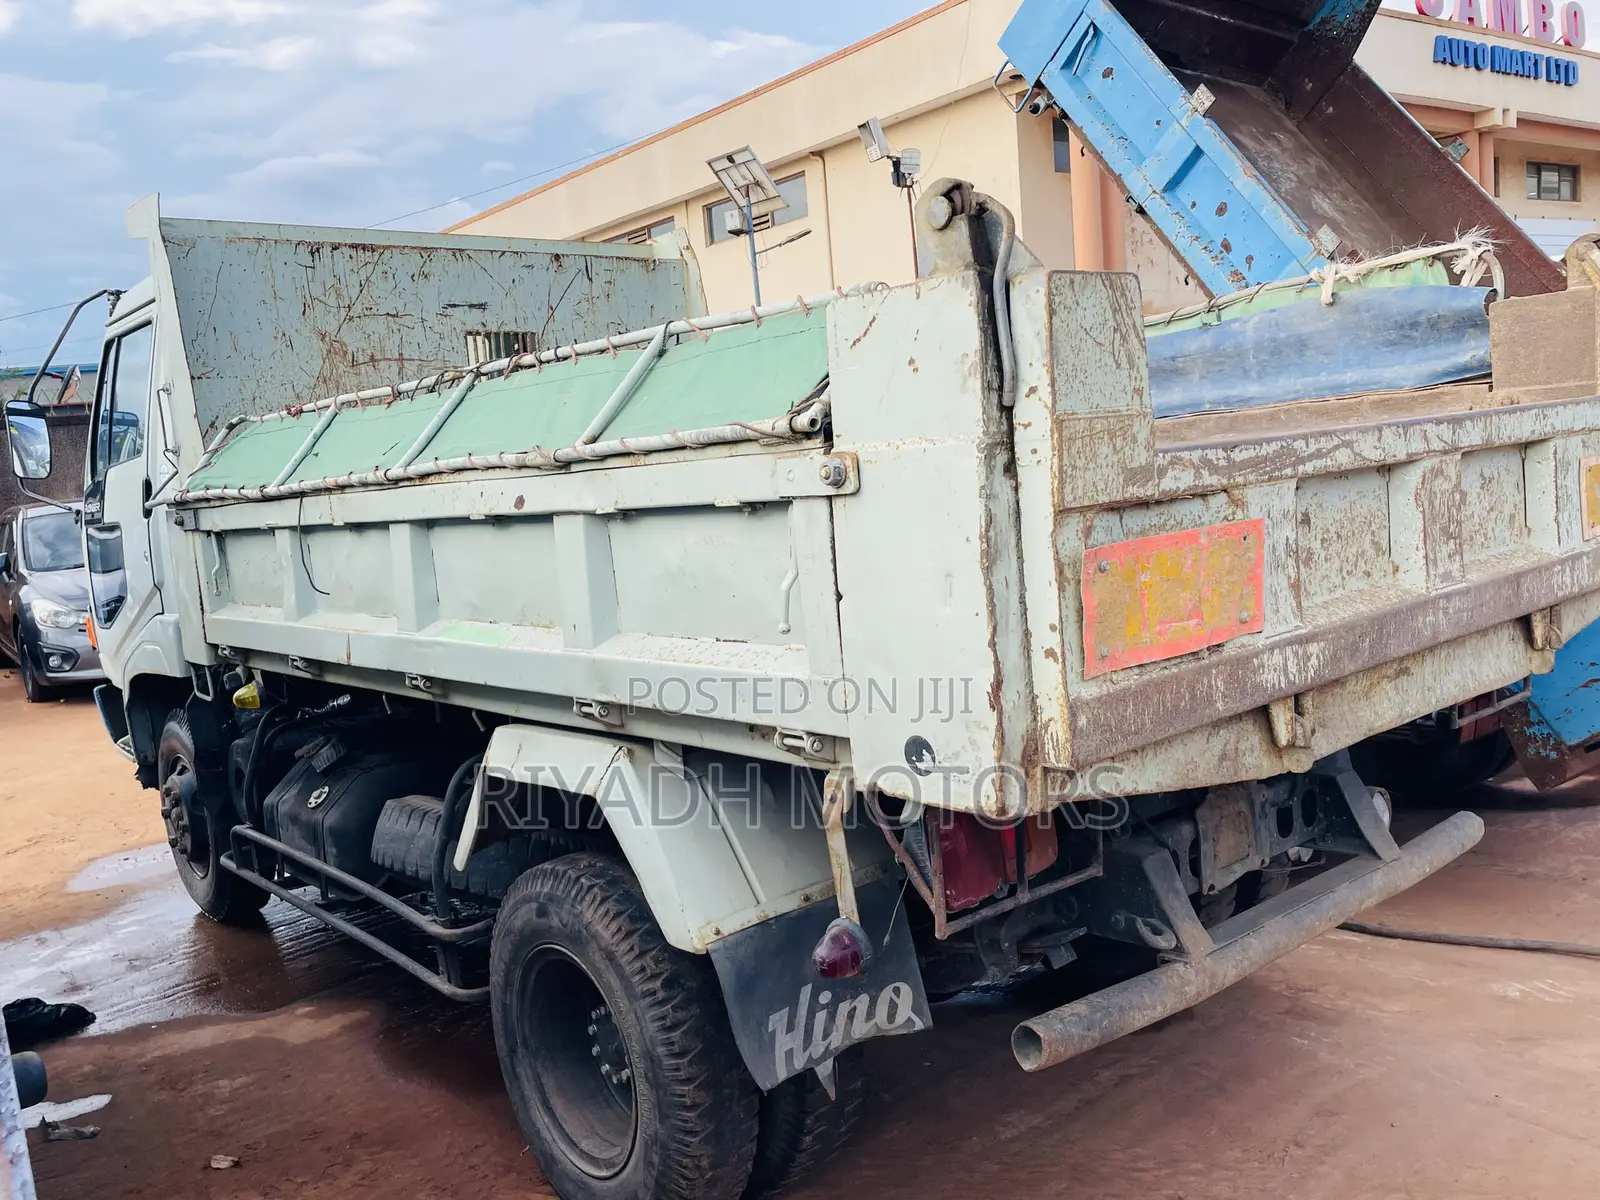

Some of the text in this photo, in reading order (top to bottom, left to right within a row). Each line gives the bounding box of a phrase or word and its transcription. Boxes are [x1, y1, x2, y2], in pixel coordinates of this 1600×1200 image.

[1433, 35, 1579, 86] AUTO MART LTD
[768, 982, 925, 1083] Hino
